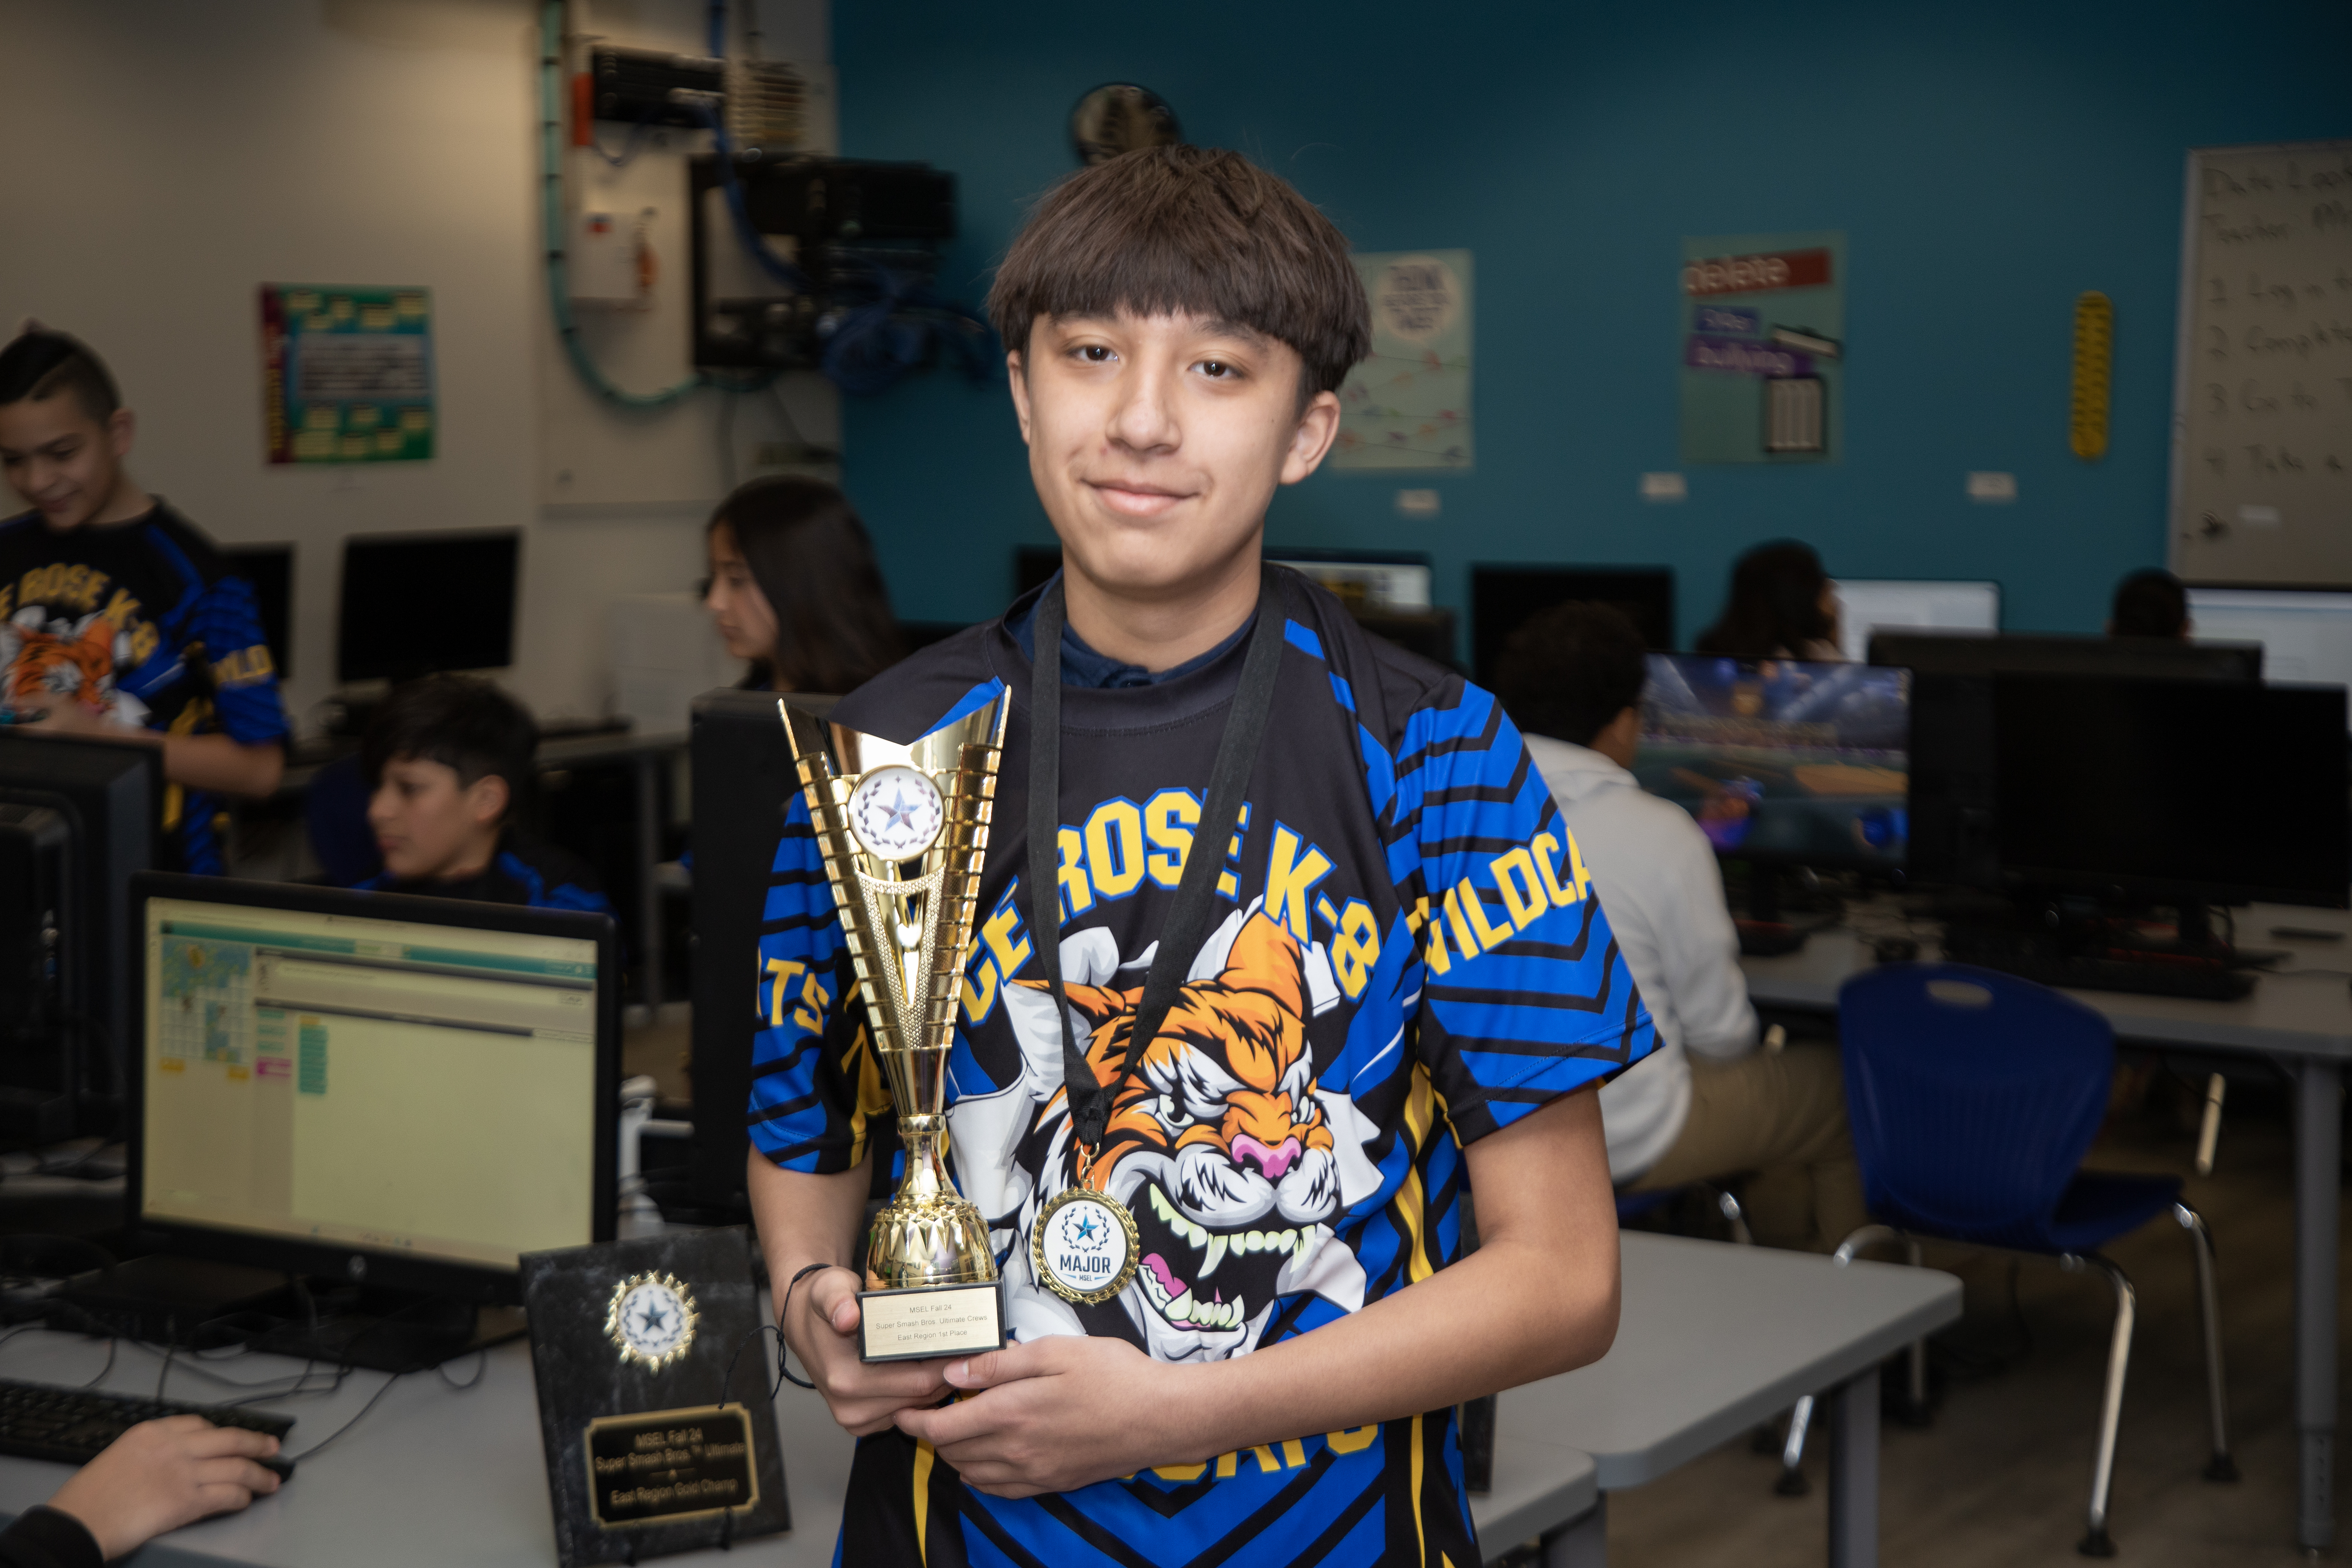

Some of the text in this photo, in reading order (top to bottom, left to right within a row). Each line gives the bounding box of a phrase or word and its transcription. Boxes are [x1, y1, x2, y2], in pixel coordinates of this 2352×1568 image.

[1261, 819, 1382, 1003] K-8
[1060, 1254, 1111, 1273] MAJOR
[635, 1427, 703, 1450] MSEL Fall 24
[595, 1456, 626, 1474] Super
[628, 1452, 665, 1470] Smash
[704, 1442, 746, 1459] Ultimate
[611, 1479, 739, 1506] East Region Gold Champ
